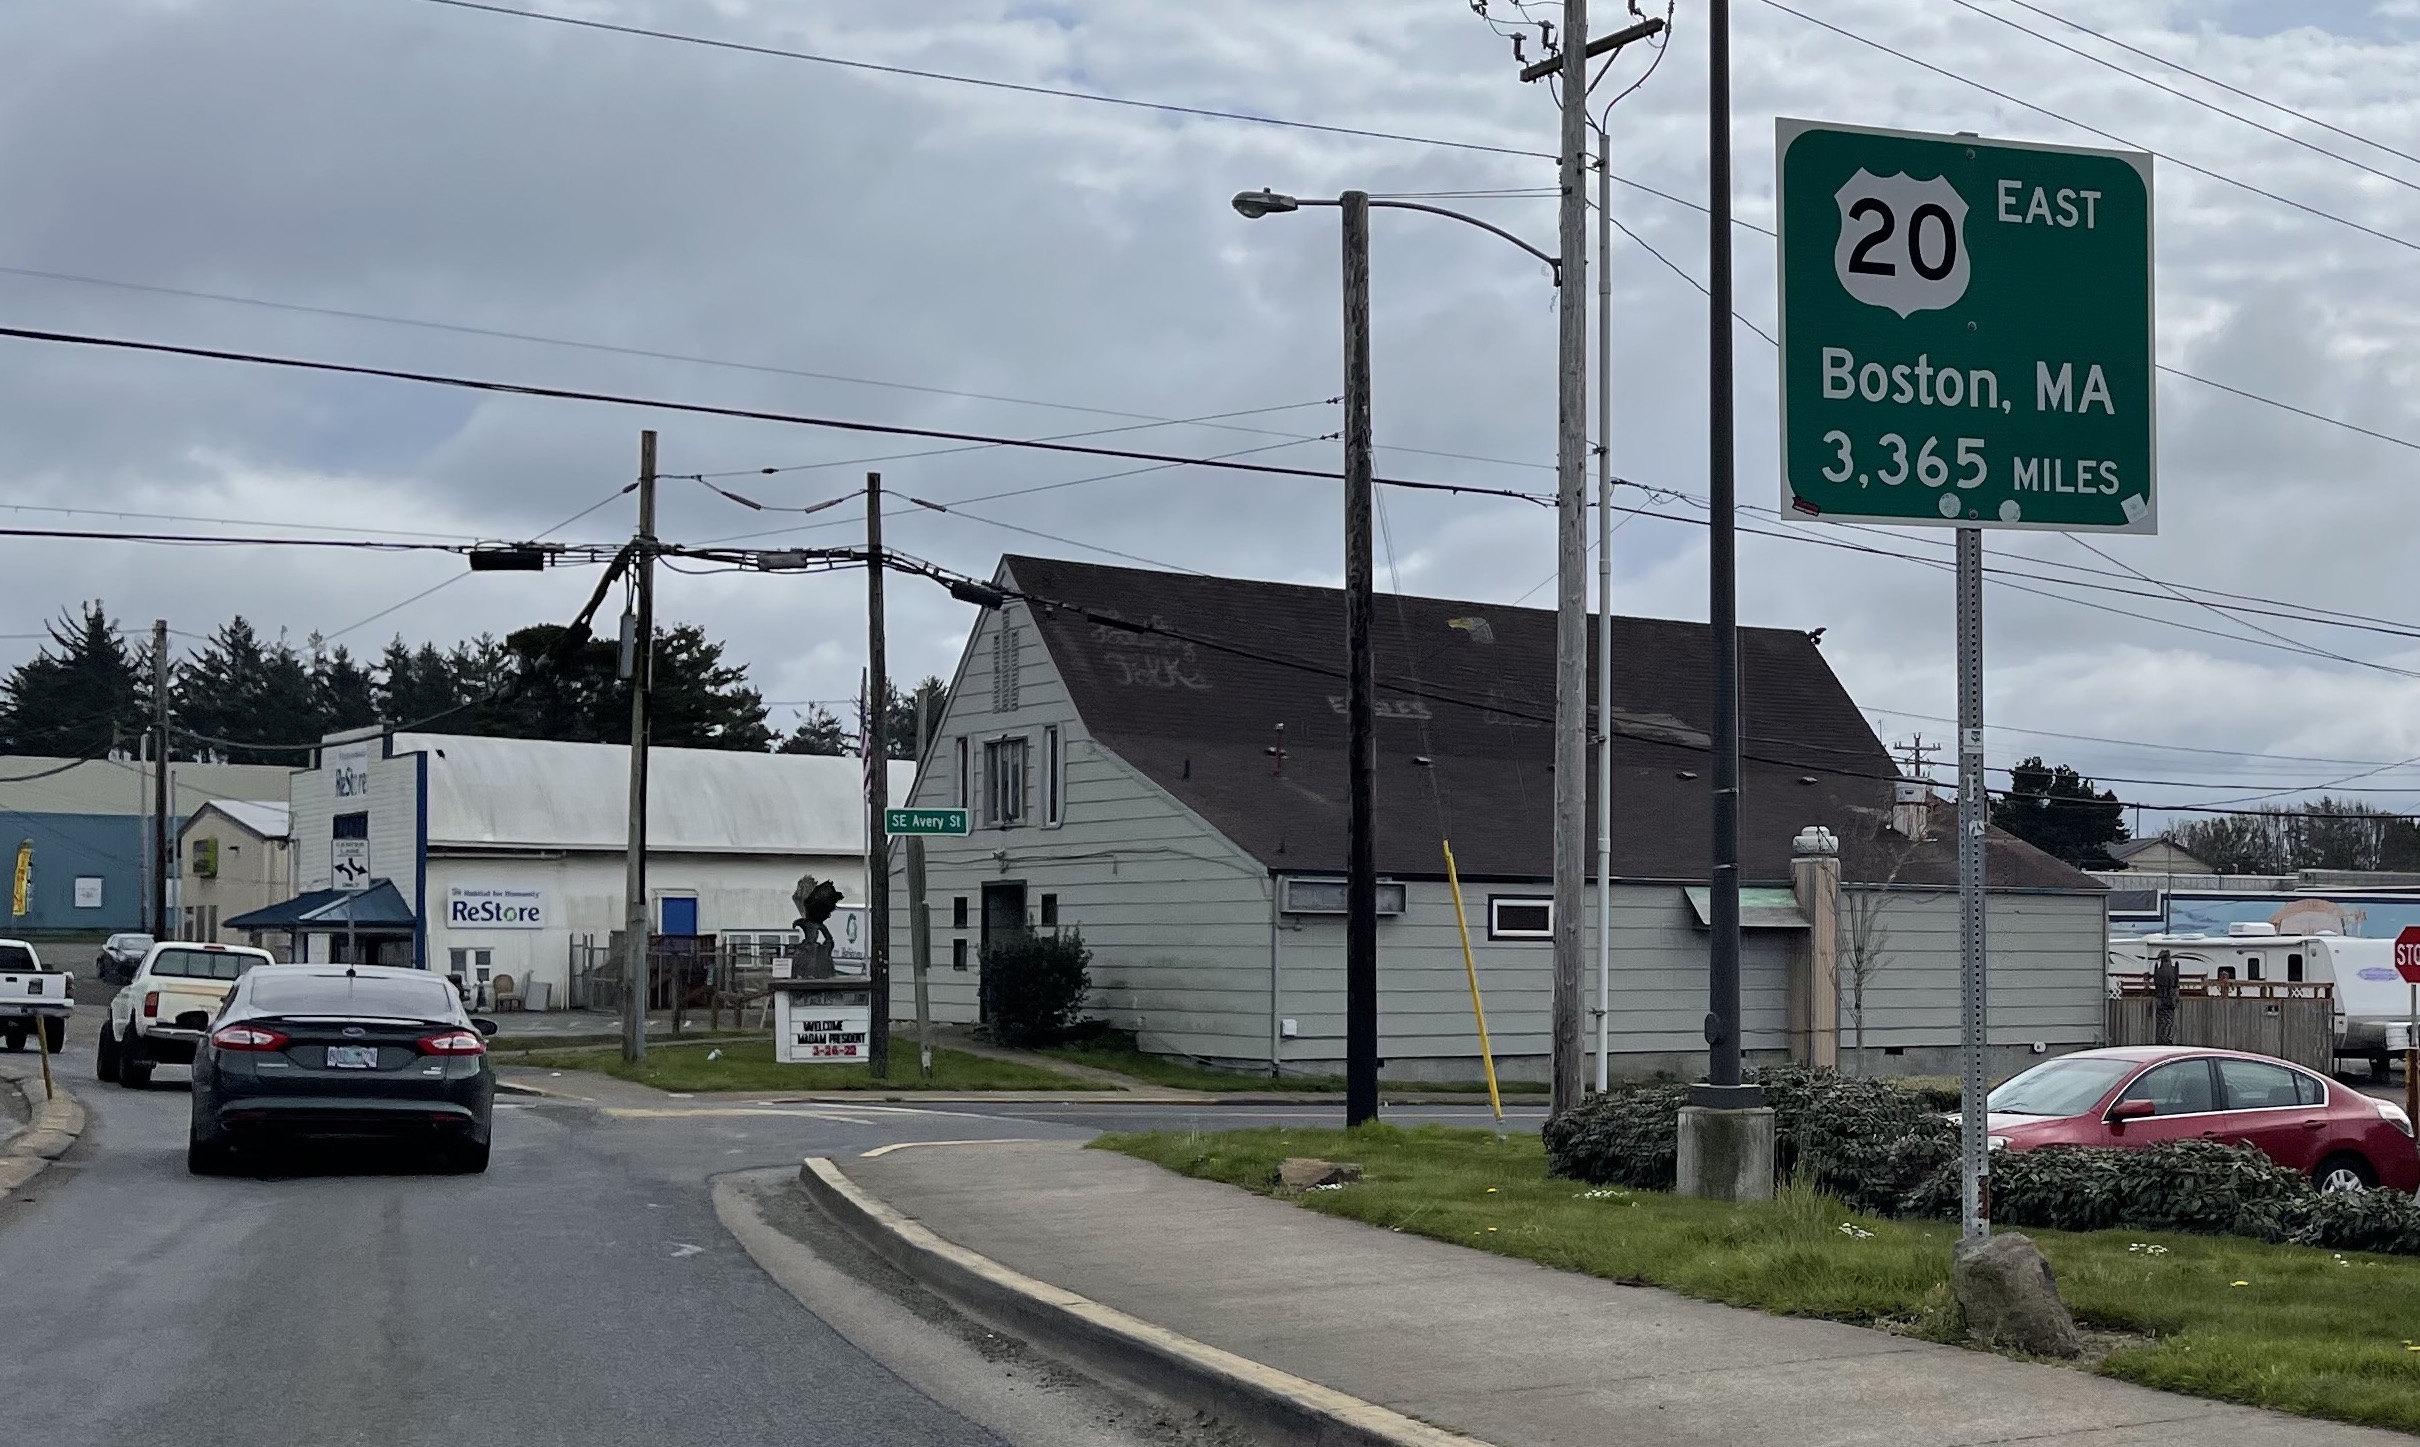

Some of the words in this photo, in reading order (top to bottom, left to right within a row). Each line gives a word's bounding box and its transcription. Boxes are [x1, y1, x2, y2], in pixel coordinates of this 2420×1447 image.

[1998, 179, 2102, 229] EAST
[1848, 197, 1957, 281] 20
[1822, 346, 2012, 415] Boston,
[2036, 360, 2116, 415] MA
[1821, 429, 1988, 489] 3,365
[2013, 456, 2120, 495] MILES
[892, 814, 907, 827] SE
[912, 814, 944, 830] Avery
[949, 814, 961, 828] St
[452, 901, 540, 922] ReStore
[2396, 943, 2420, 966] STO
